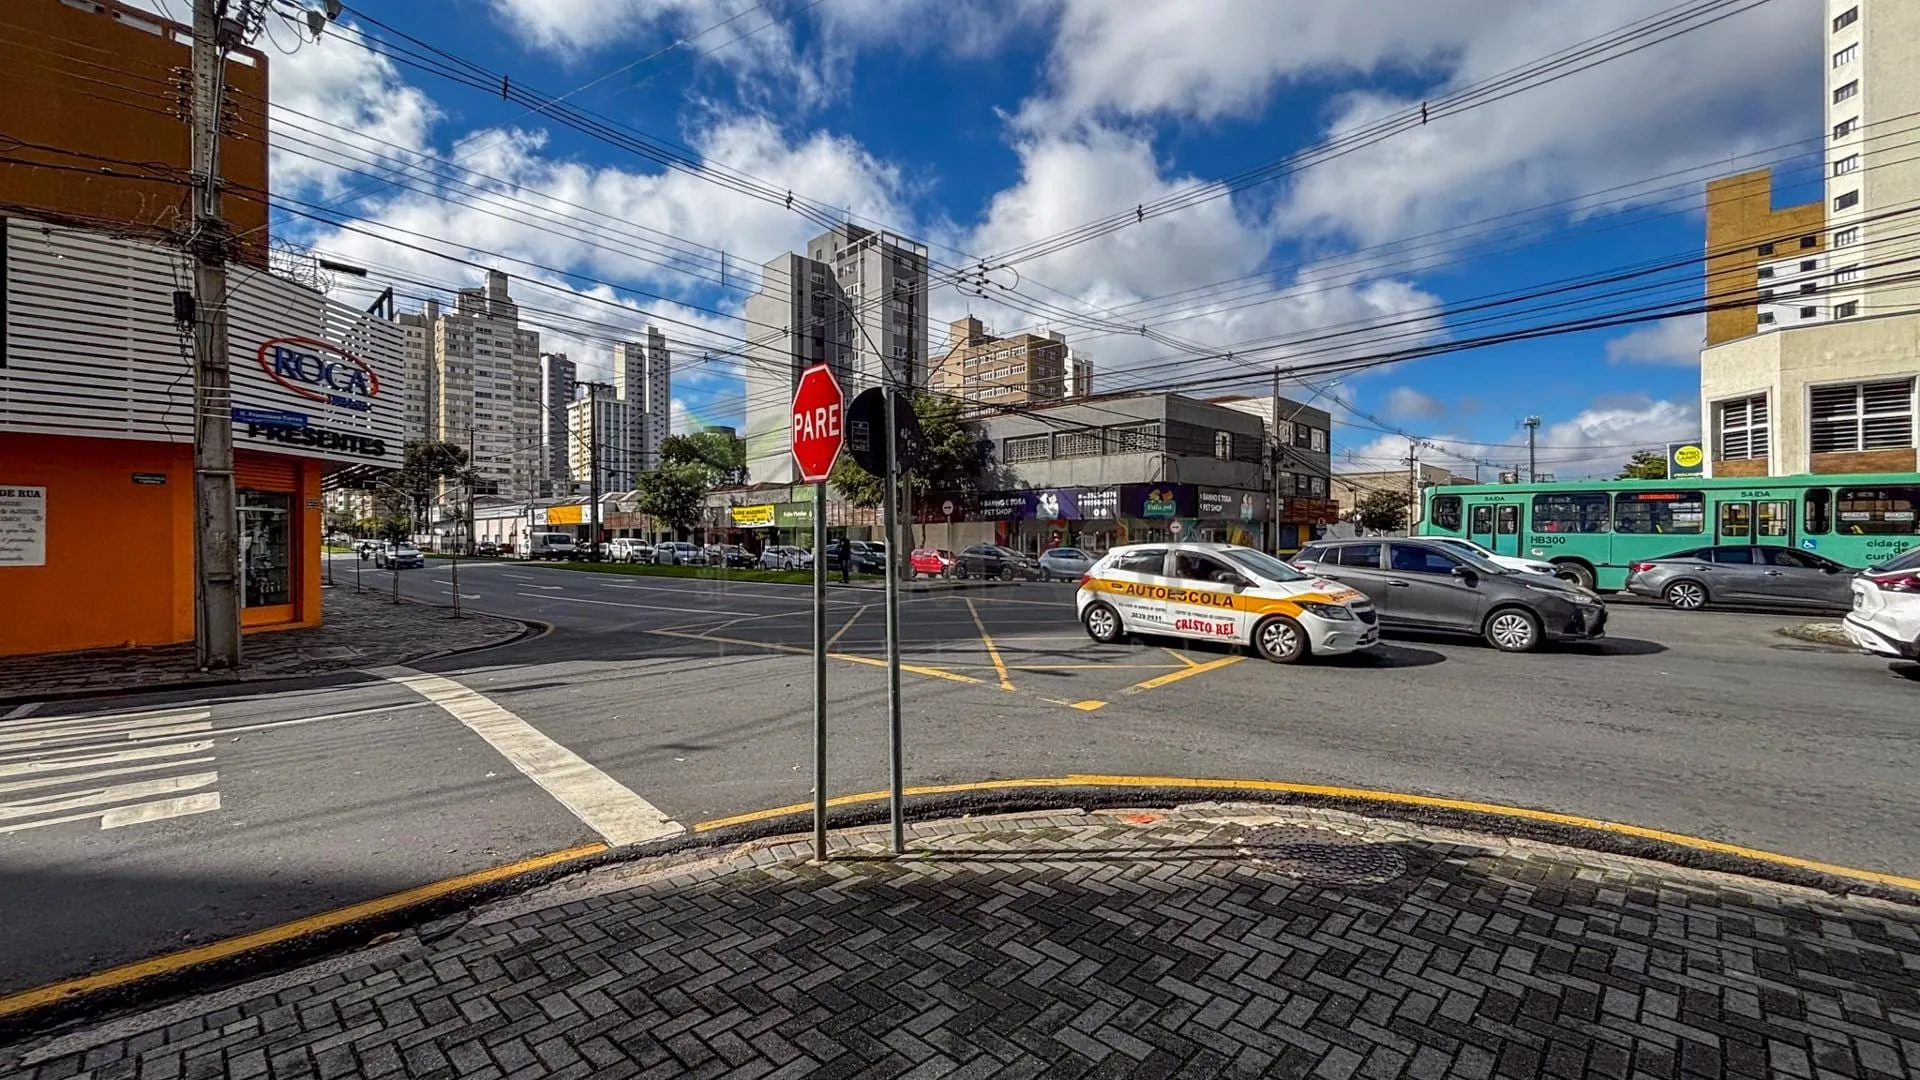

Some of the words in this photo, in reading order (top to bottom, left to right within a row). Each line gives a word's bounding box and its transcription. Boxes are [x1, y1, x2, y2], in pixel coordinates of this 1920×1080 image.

[275, 346, 369, 396] ROCA
[794, 403, 840, 443] PARE
[248, 423, 386, 456] PRESENTES
[0, 489, 15, 498] DE
[18, 489, 41, 498] RUA
[1530, 535, 1566, 545] HB300
[1866, 540, 1909, 549] cidade
[1126, 583, 1234, 608] AUTOESCOLA
[1175, 619, 1212, 634] CRISTO
[1216, 622, 1234, 636] REI
